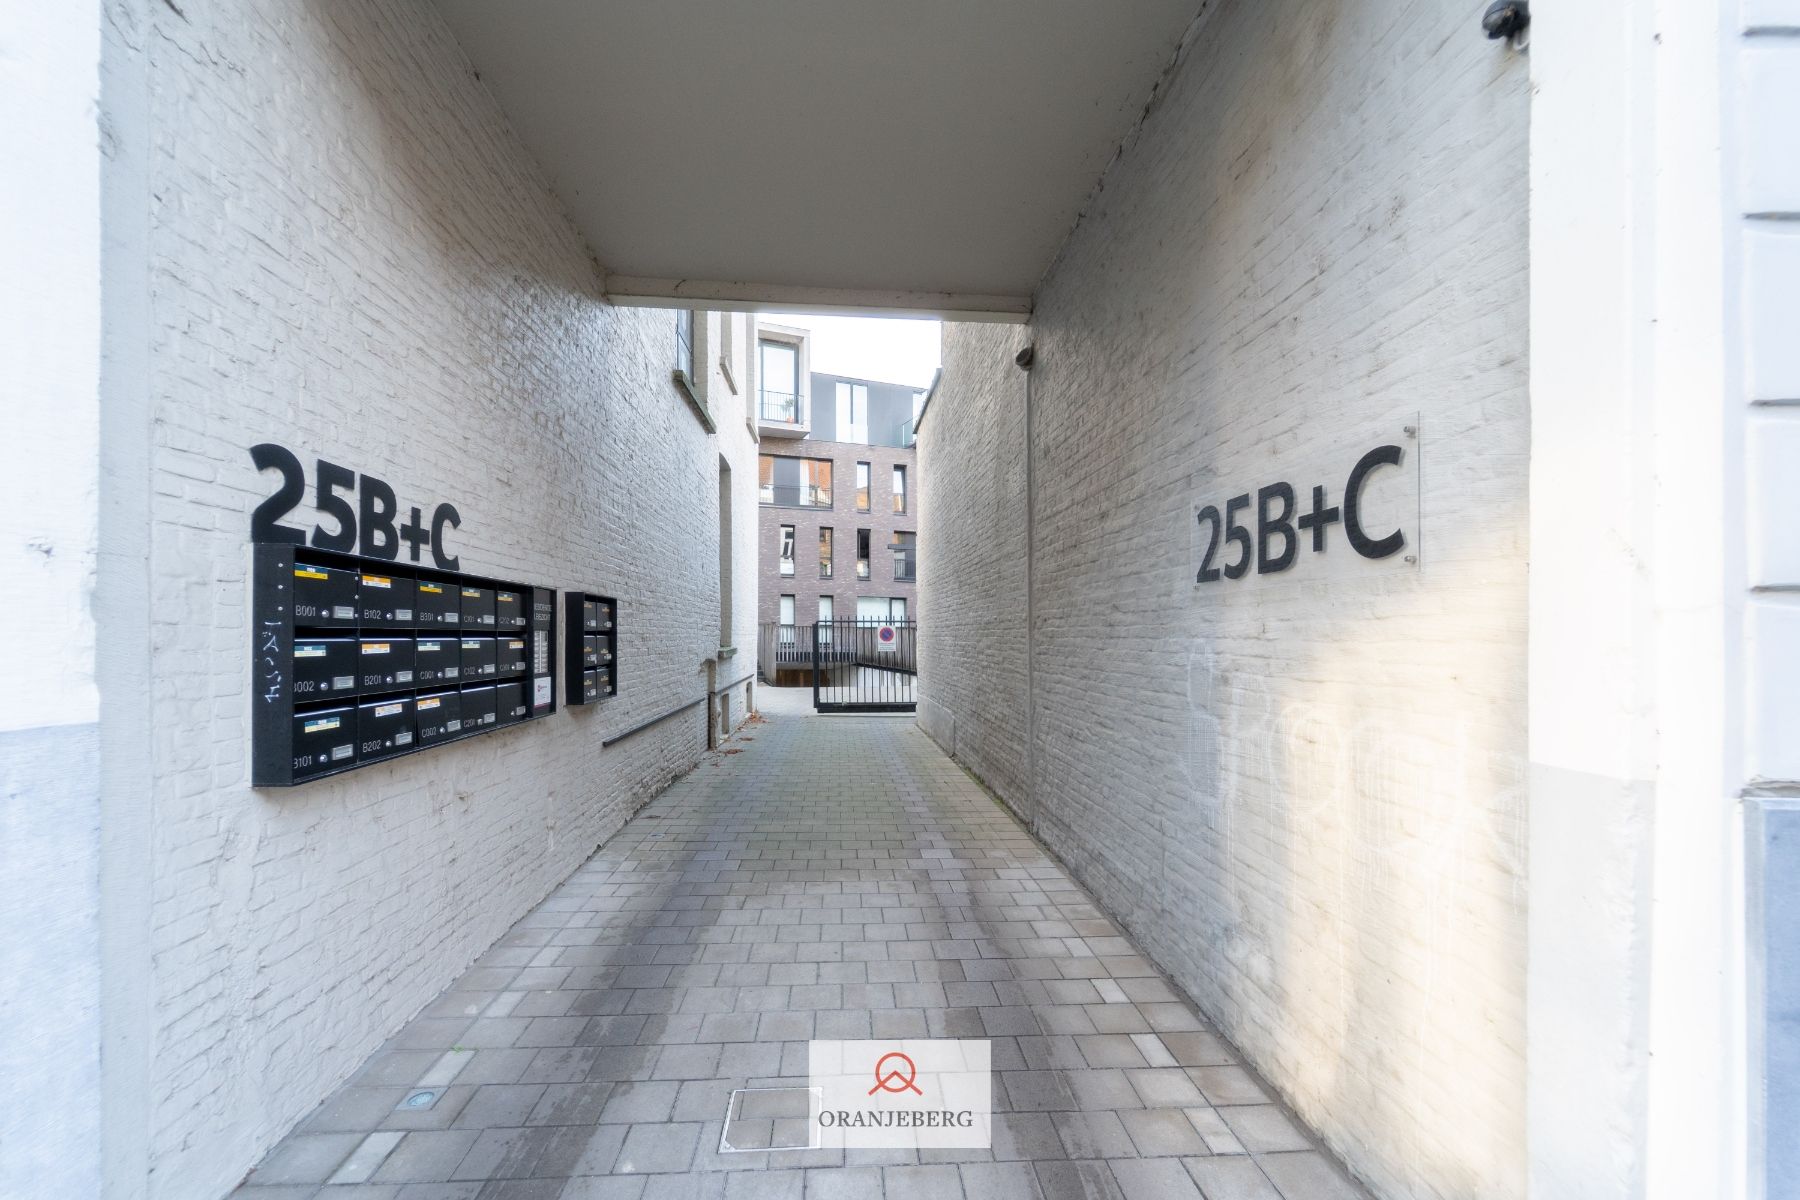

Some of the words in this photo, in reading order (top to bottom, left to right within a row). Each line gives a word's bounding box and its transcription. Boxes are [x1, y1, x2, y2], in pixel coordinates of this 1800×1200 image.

[250, 443, 461, 571] 25B+C
[1196, 444, 1404, 583] 25B+C
[295, 605, 316, 617] B001
[364, 609, 381, 619] B102
[420, 612, 434, 621] B301
[364, 675, 381, 686] B201
[420, 670, 434, 680] C001
[421, 726, 437, 738] C002
[362, 740, 381, 753] B202
